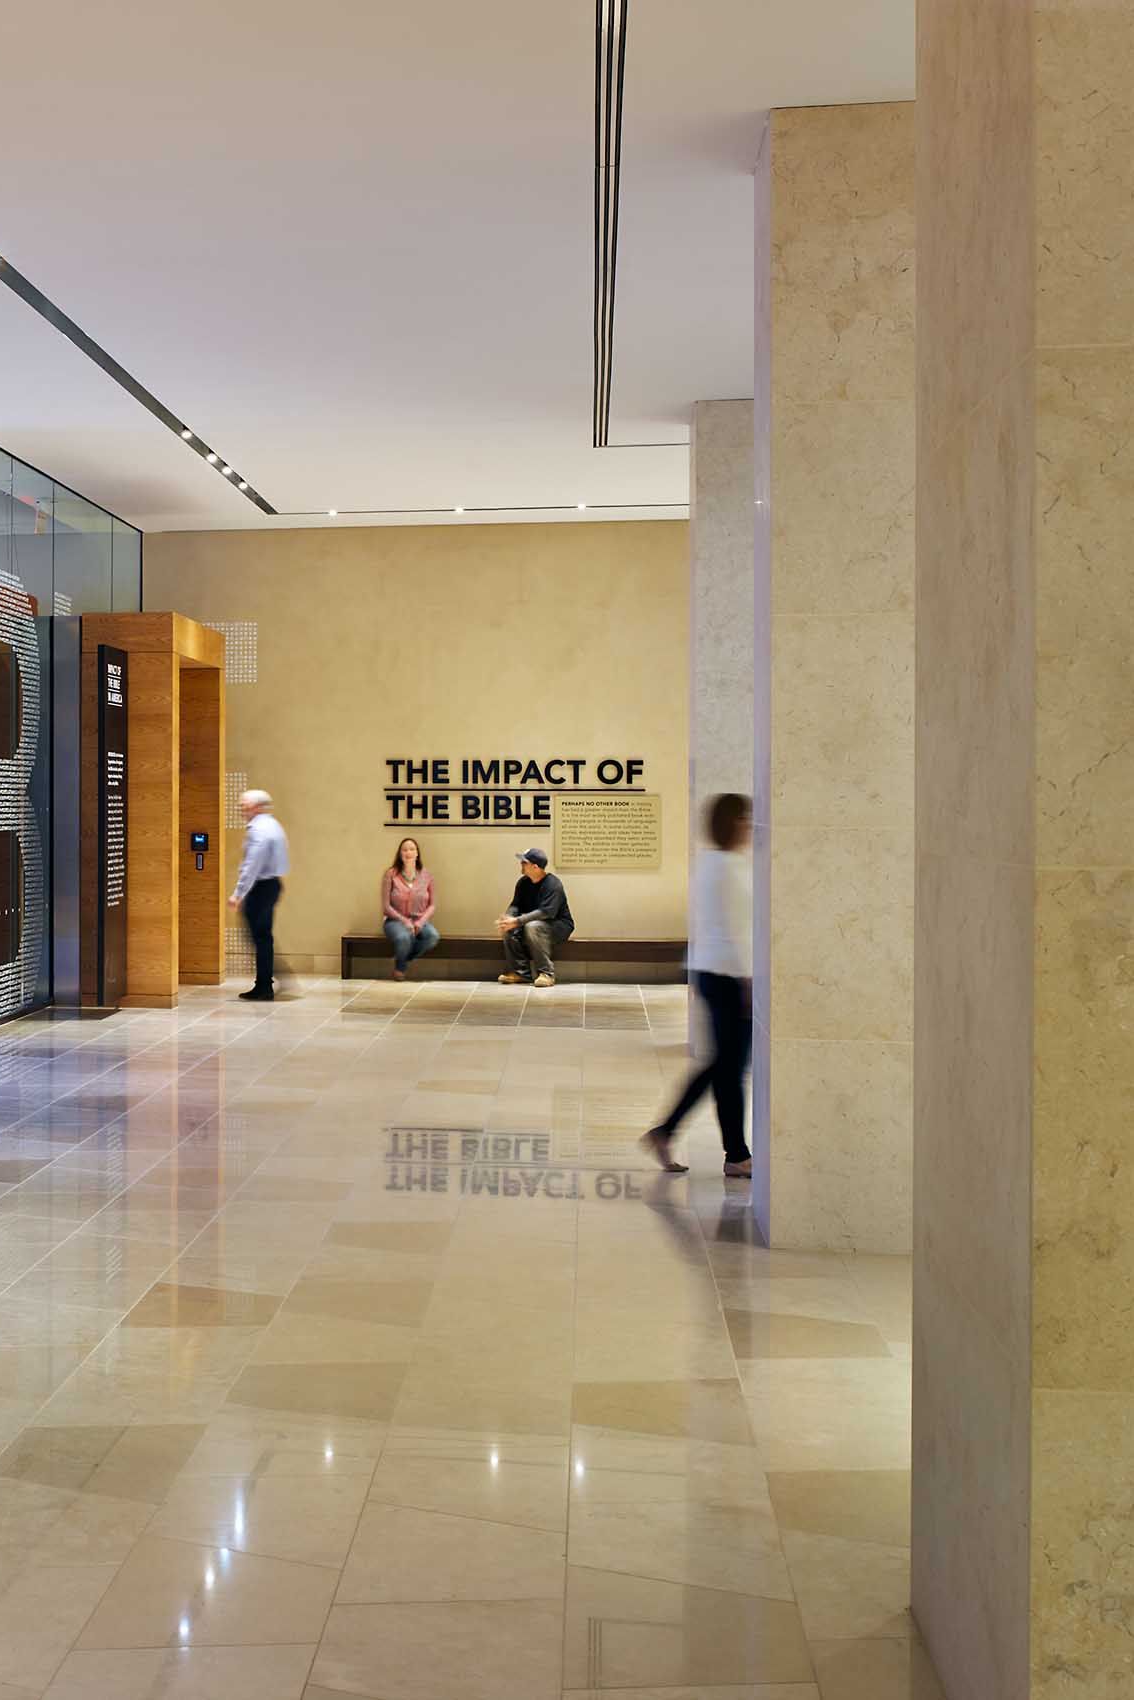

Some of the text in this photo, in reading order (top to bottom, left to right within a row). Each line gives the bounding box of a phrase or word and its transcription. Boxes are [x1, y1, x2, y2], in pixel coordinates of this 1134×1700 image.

[385, 759, 644, 784] THE IMPACT OF
[385, 795, 552, 819] THE BIBLE
